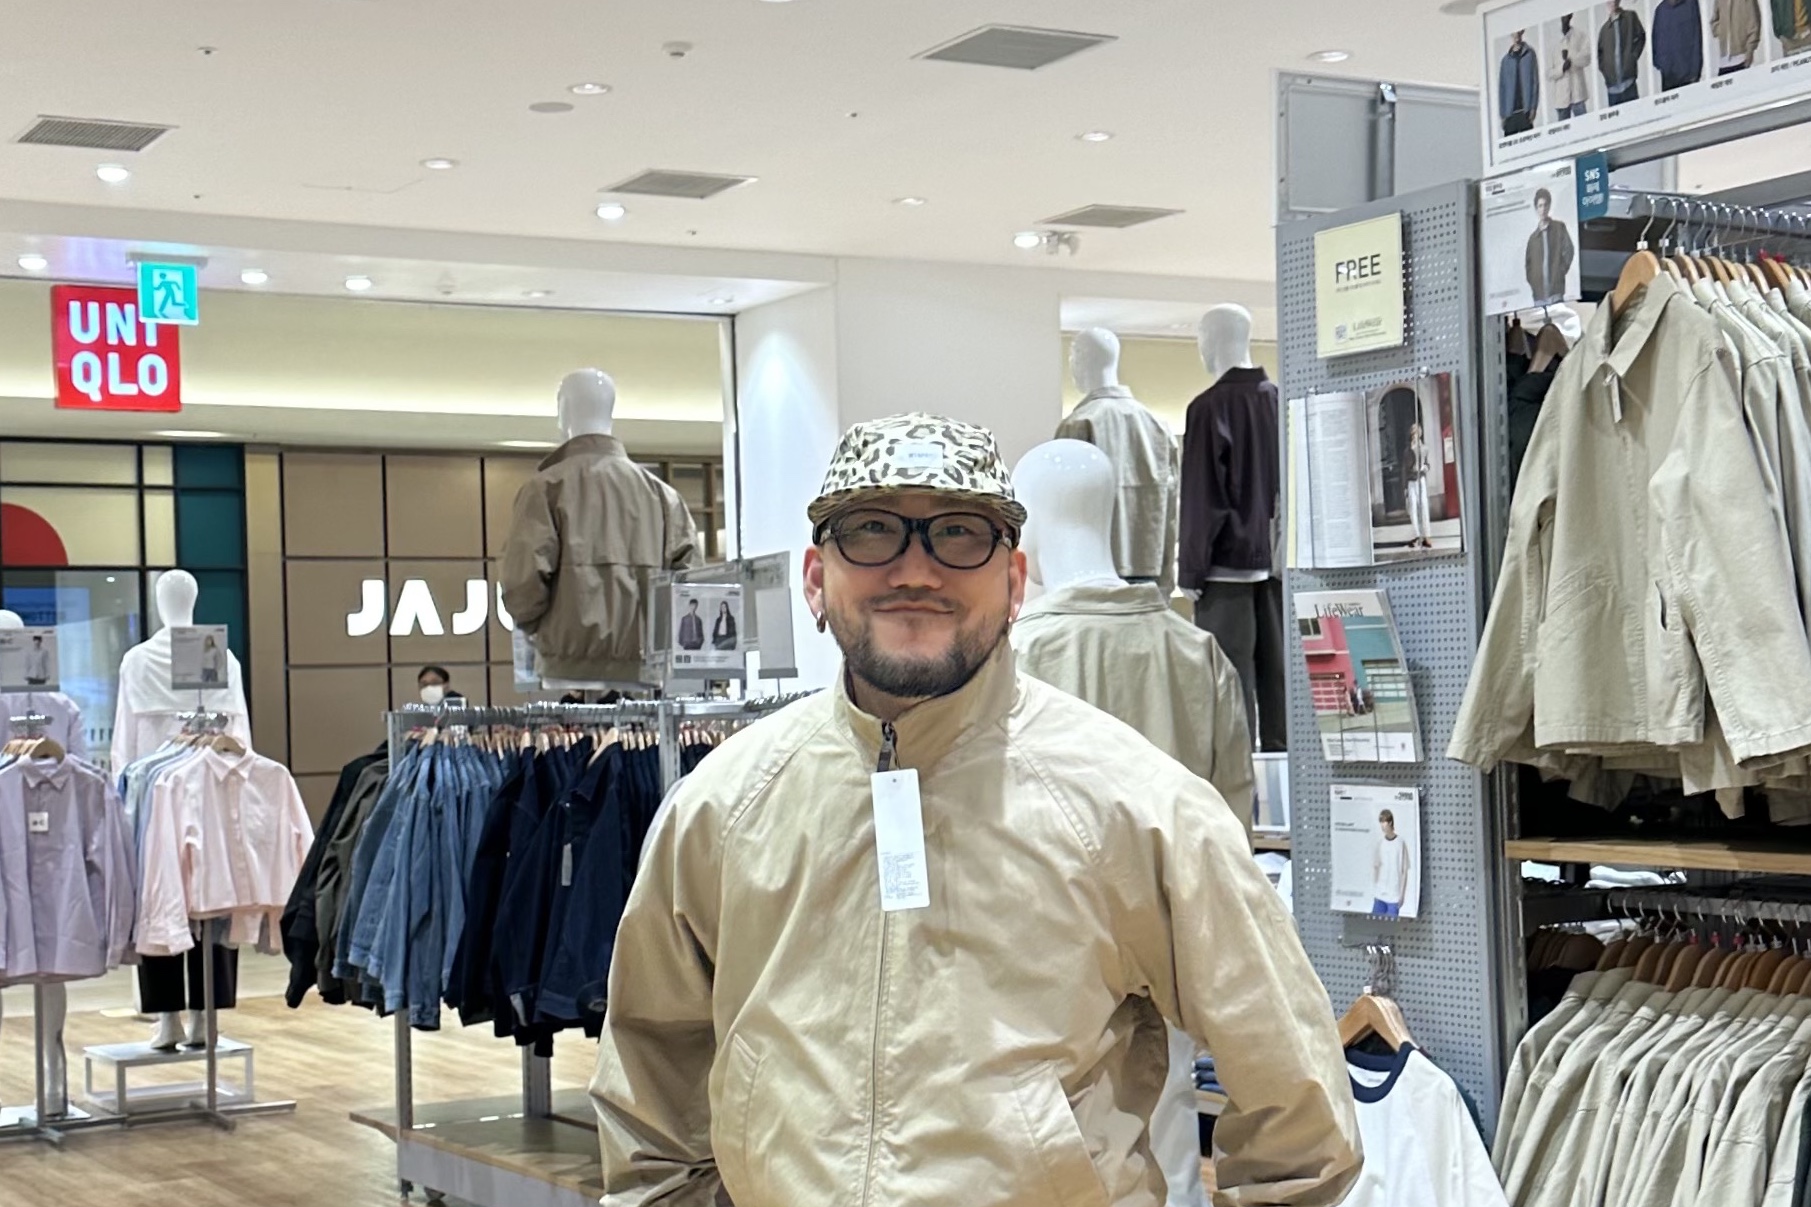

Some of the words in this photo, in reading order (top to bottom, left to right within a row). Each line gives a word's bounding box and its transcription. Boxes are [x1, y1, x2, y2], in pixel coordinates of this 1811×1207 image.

[1584, 167, 1601, 181] SNS
[1335, 253, 1382, 284] FREE
[70, 350, 169, 403] QLO
[1314, 602, 1364, 619] LifeWear
